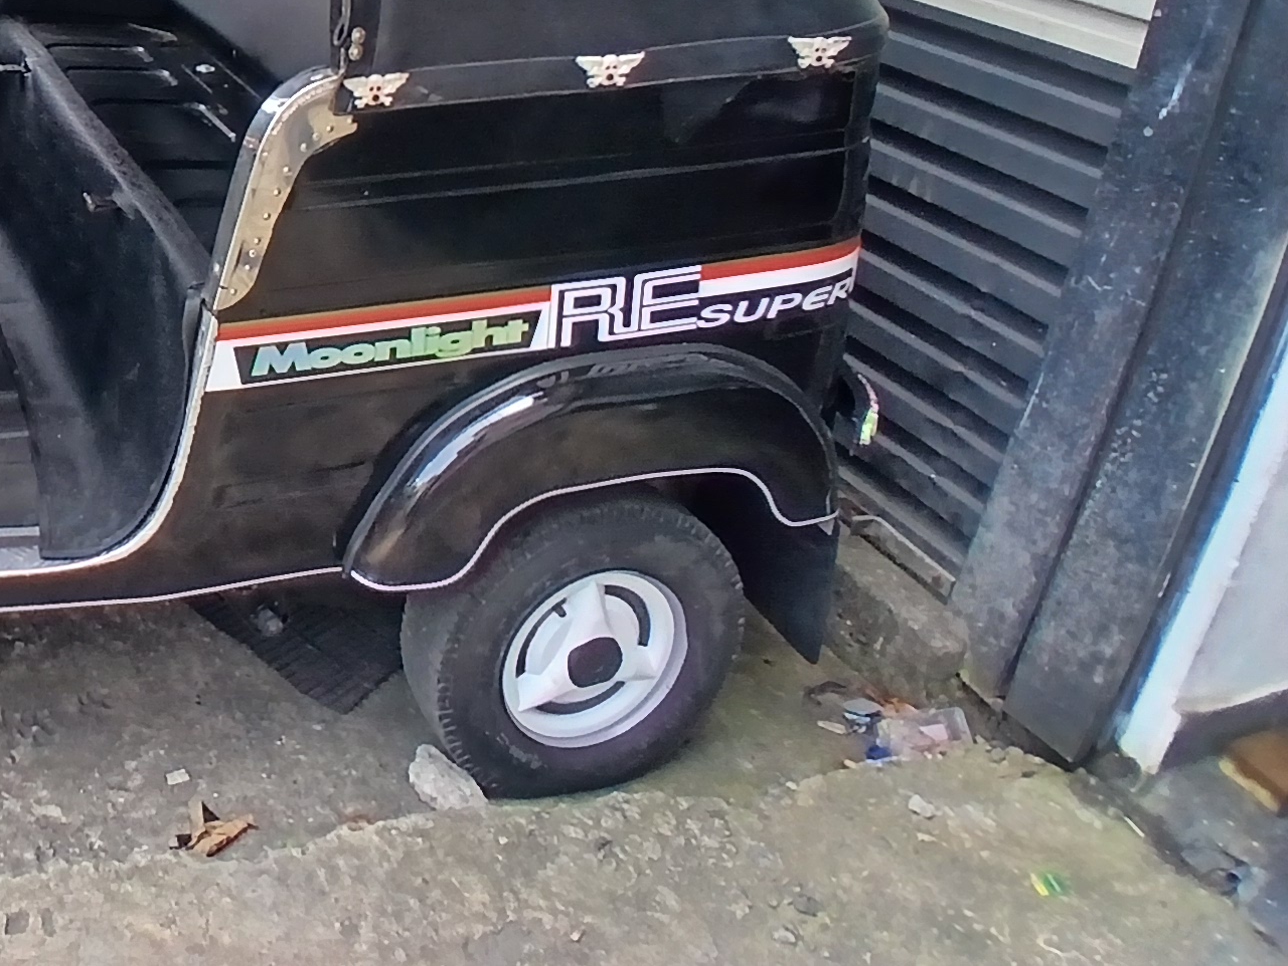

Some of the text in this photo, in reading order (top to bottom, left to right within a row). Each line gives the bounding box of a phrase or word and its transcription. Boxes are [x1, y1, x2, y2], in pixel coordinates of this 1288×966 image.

[251, 265, 850, 377] Moonlight RE SUPER
